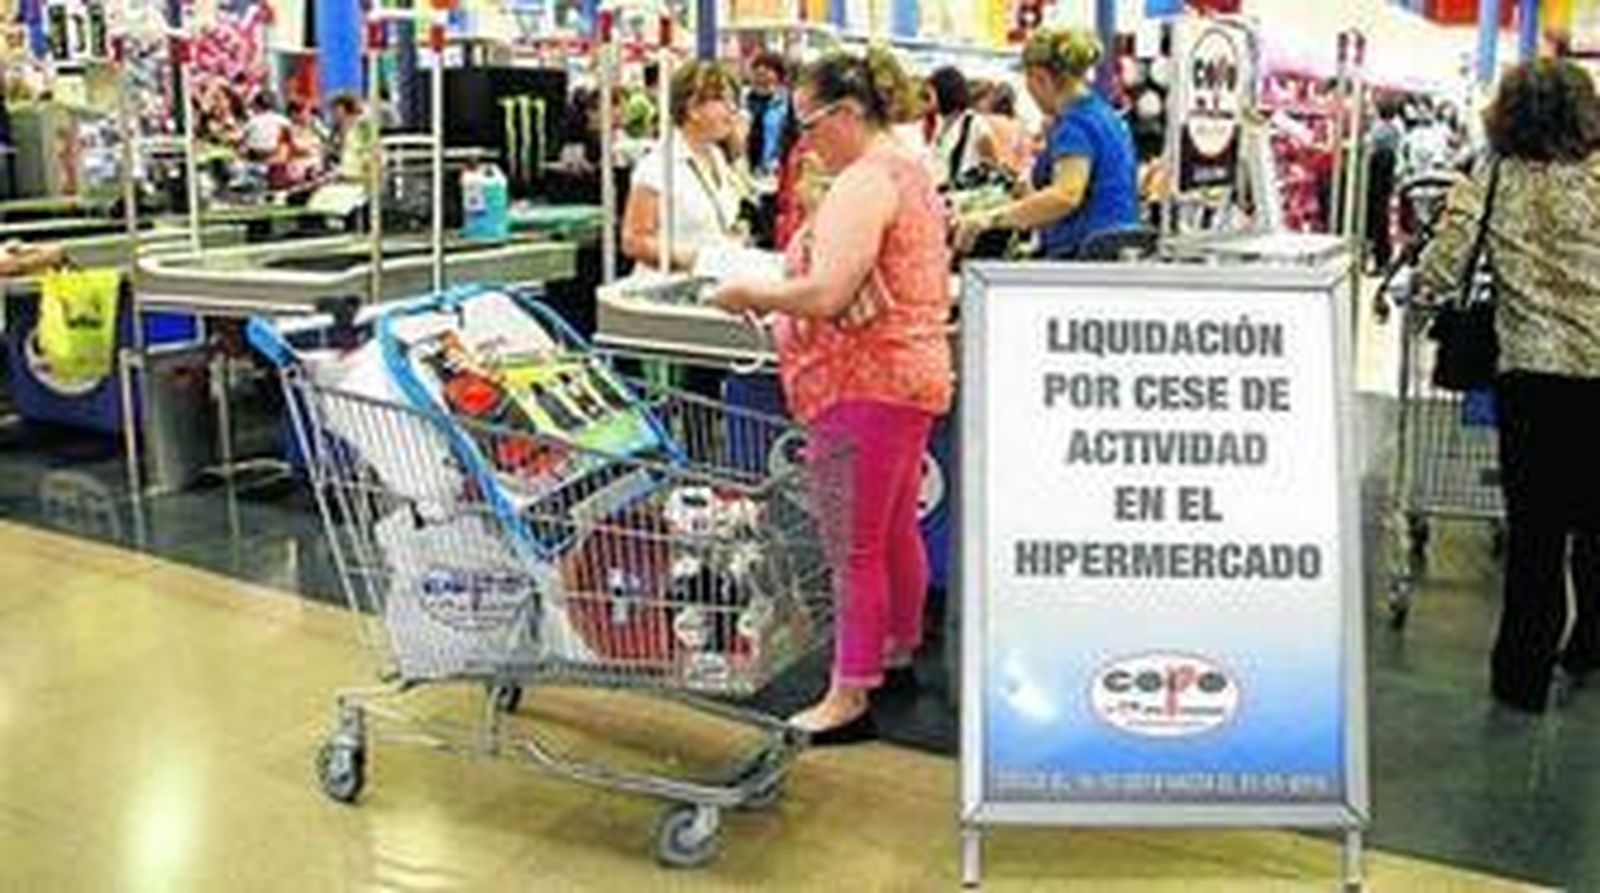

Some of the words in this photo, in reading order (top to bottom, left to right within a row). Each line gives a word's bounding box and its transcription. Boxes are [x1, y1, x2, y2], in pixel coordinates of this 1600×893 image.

[1047, 314, 1284, 358] LIQUIDACIÓN
[1043, 373, 1120, 409] POR
[1134, 375, 1230, 411] CESE
[1240, 377, 1291, 412] DE
[1065, 429, 1268, 466] ACTIVIDAD
[1113, 485, 1166, 522] EN
[1178, 486, 1223, 522] EL
[1014, 540, 1323, 579] HIPERMERCADO
